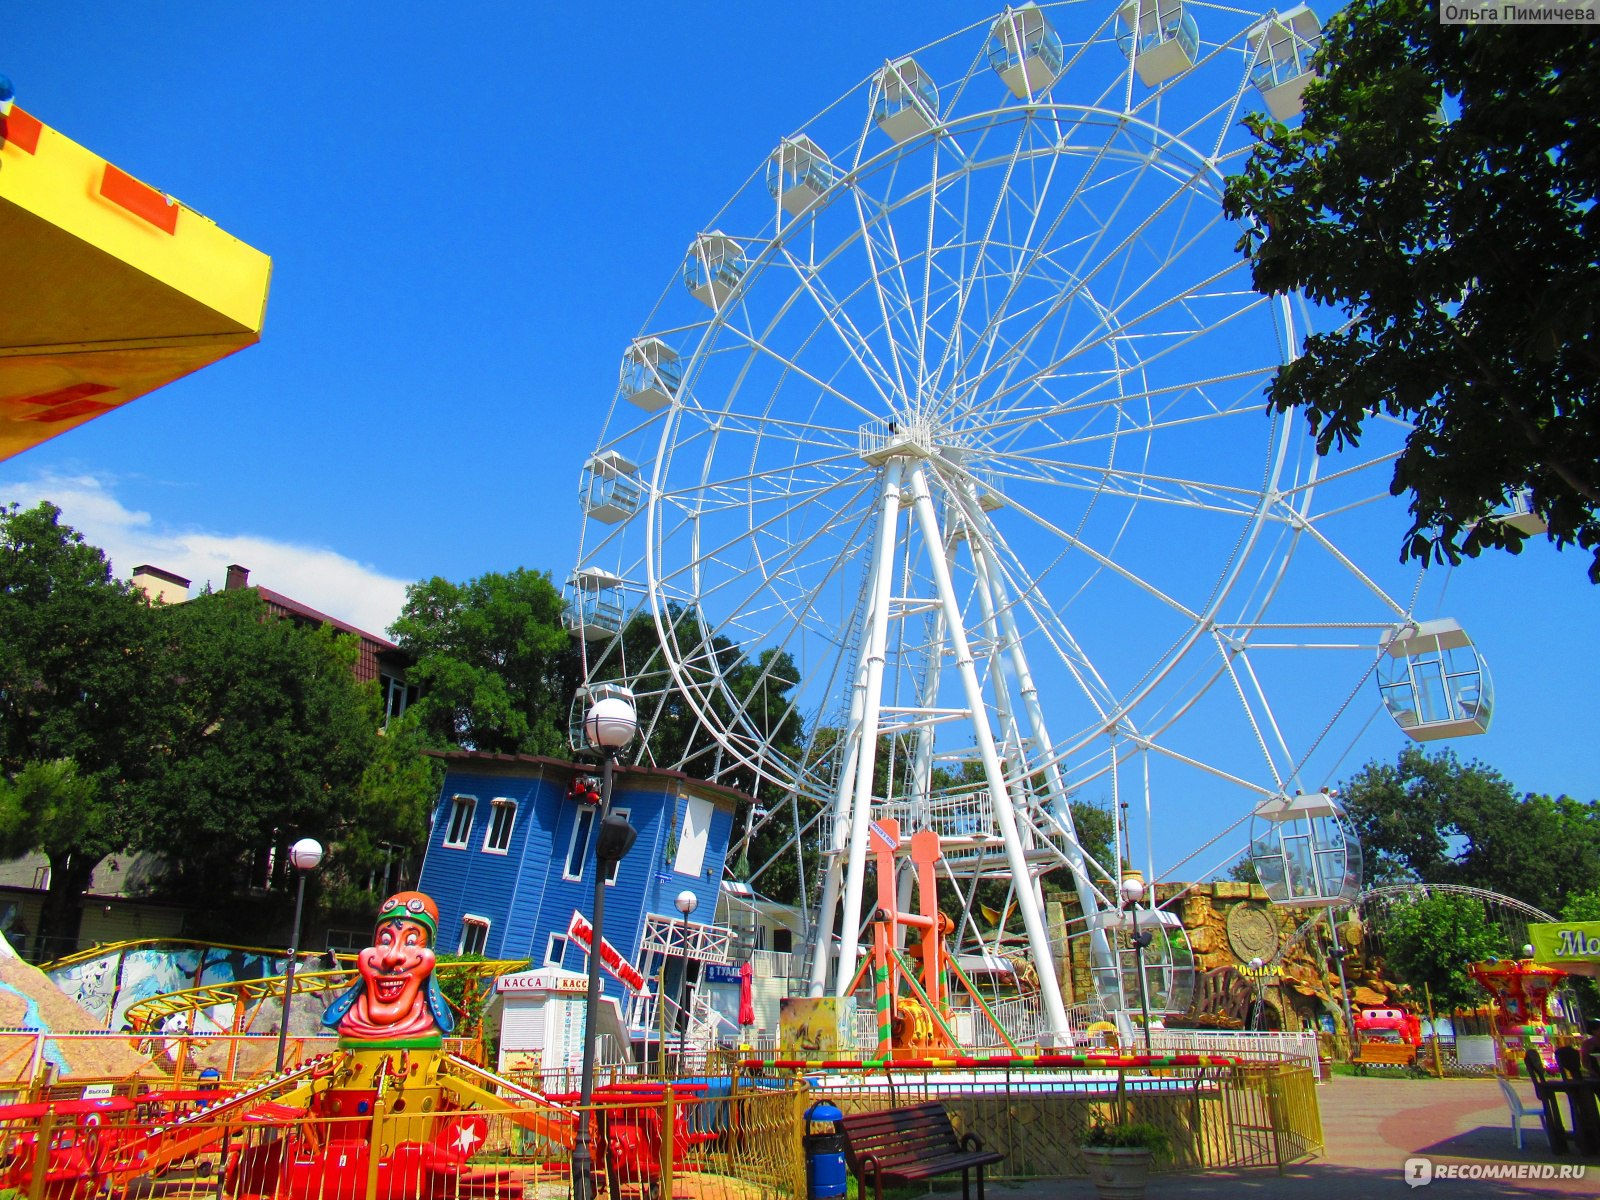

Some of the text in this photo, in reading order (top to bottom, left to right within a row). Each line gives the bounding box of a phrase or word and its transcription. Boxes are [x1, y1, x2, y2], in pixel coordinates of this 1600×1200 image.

[716, 966, 742, 977] ТУАЛЕ
[504, 978, 542, 987] КАССА
[563, 979, 587, 988] КАСС
